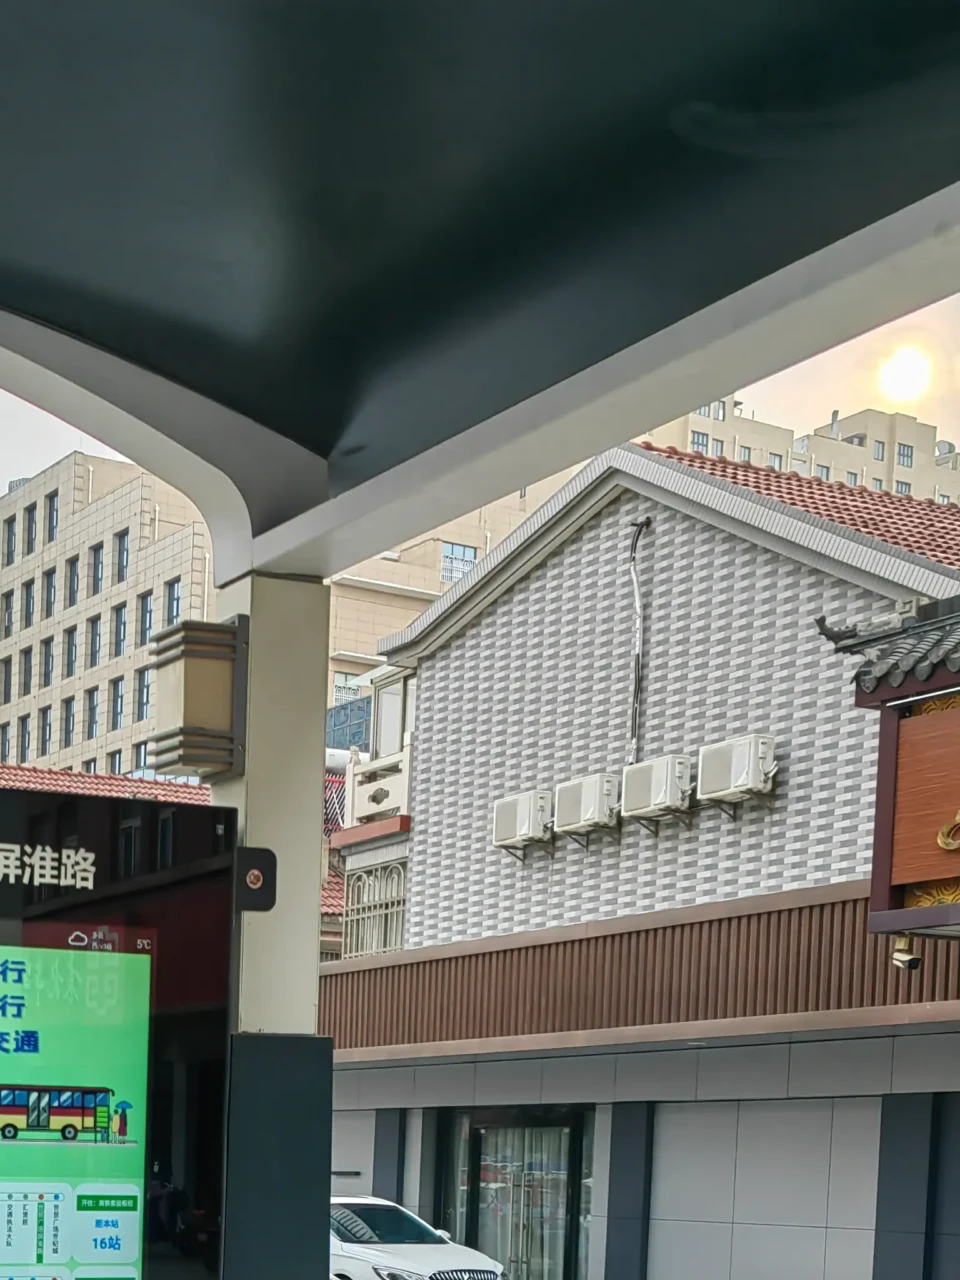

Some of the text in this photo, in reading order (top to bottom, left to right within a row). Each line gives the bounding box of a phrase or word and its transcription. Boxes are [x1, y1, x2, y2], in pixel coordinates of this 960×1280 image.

[94, 1219, 119, 1229] 距本站
[92, 1236, 121, 1251] 16站
